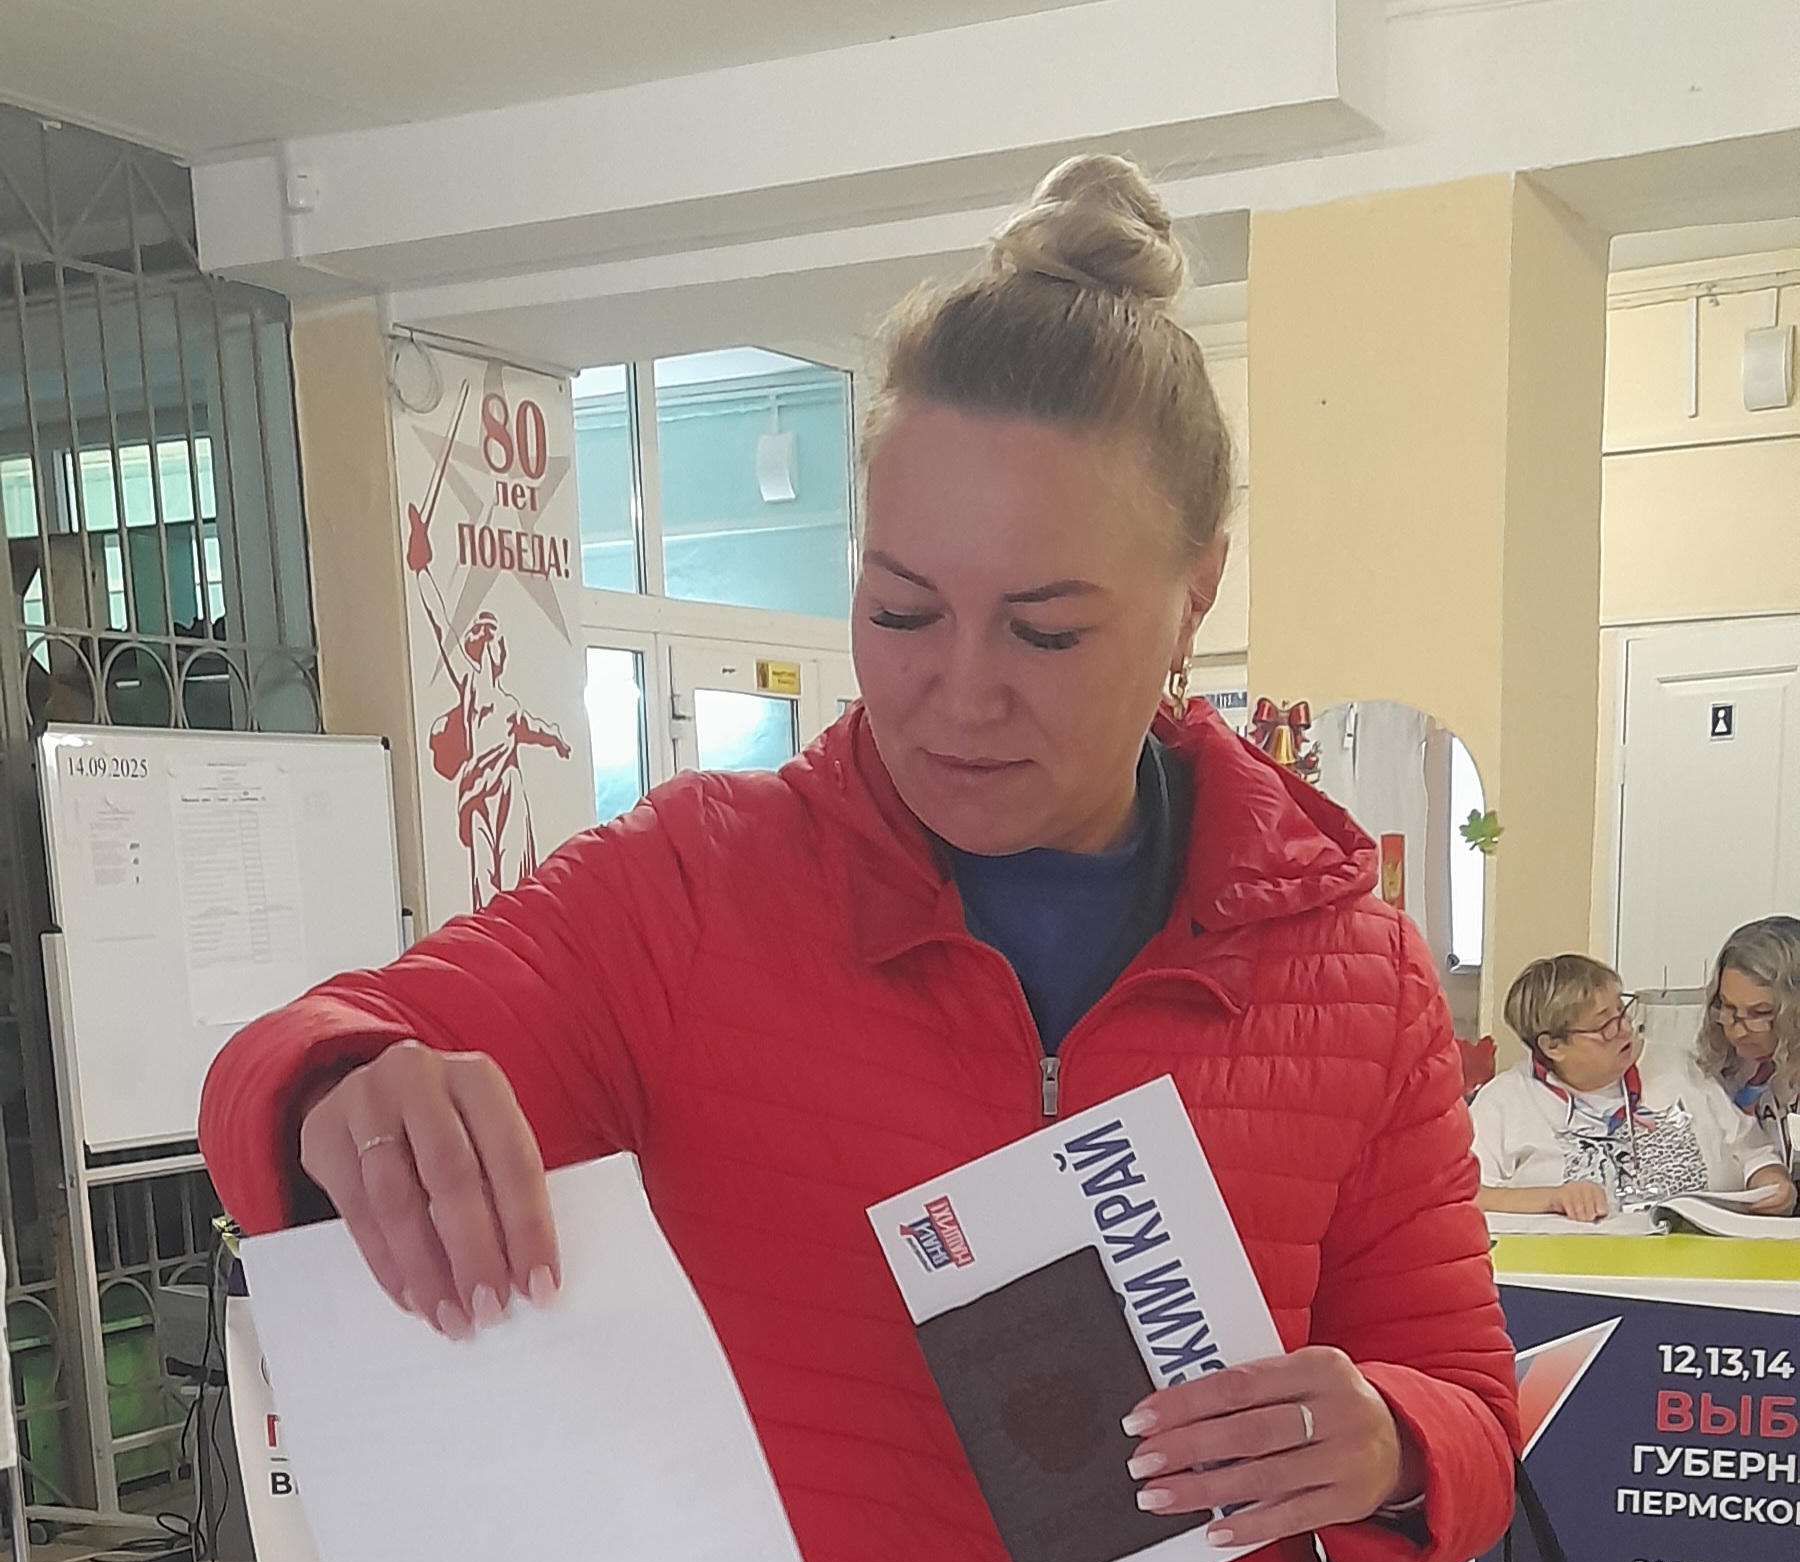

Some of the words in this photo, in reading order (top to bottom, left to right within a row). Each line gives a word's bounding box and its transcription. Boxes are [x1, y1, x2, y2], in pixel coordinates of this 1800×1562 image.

[482, 393, 546, 479] 80
[495, 480, 539, 512] лет
[458, 522, 570, 580] ПОБЕДА!
[68, 756, 149, 778] 14.09.2025
[1053, 1119, 1171, 1264] КРАЙ
[1658, 1344, 1795, 1380] 12,13,14
[1656, 1390, 1800, 1438] ВЫБ
[1633, 1445, 1800, 1484] ГУБЕРН
